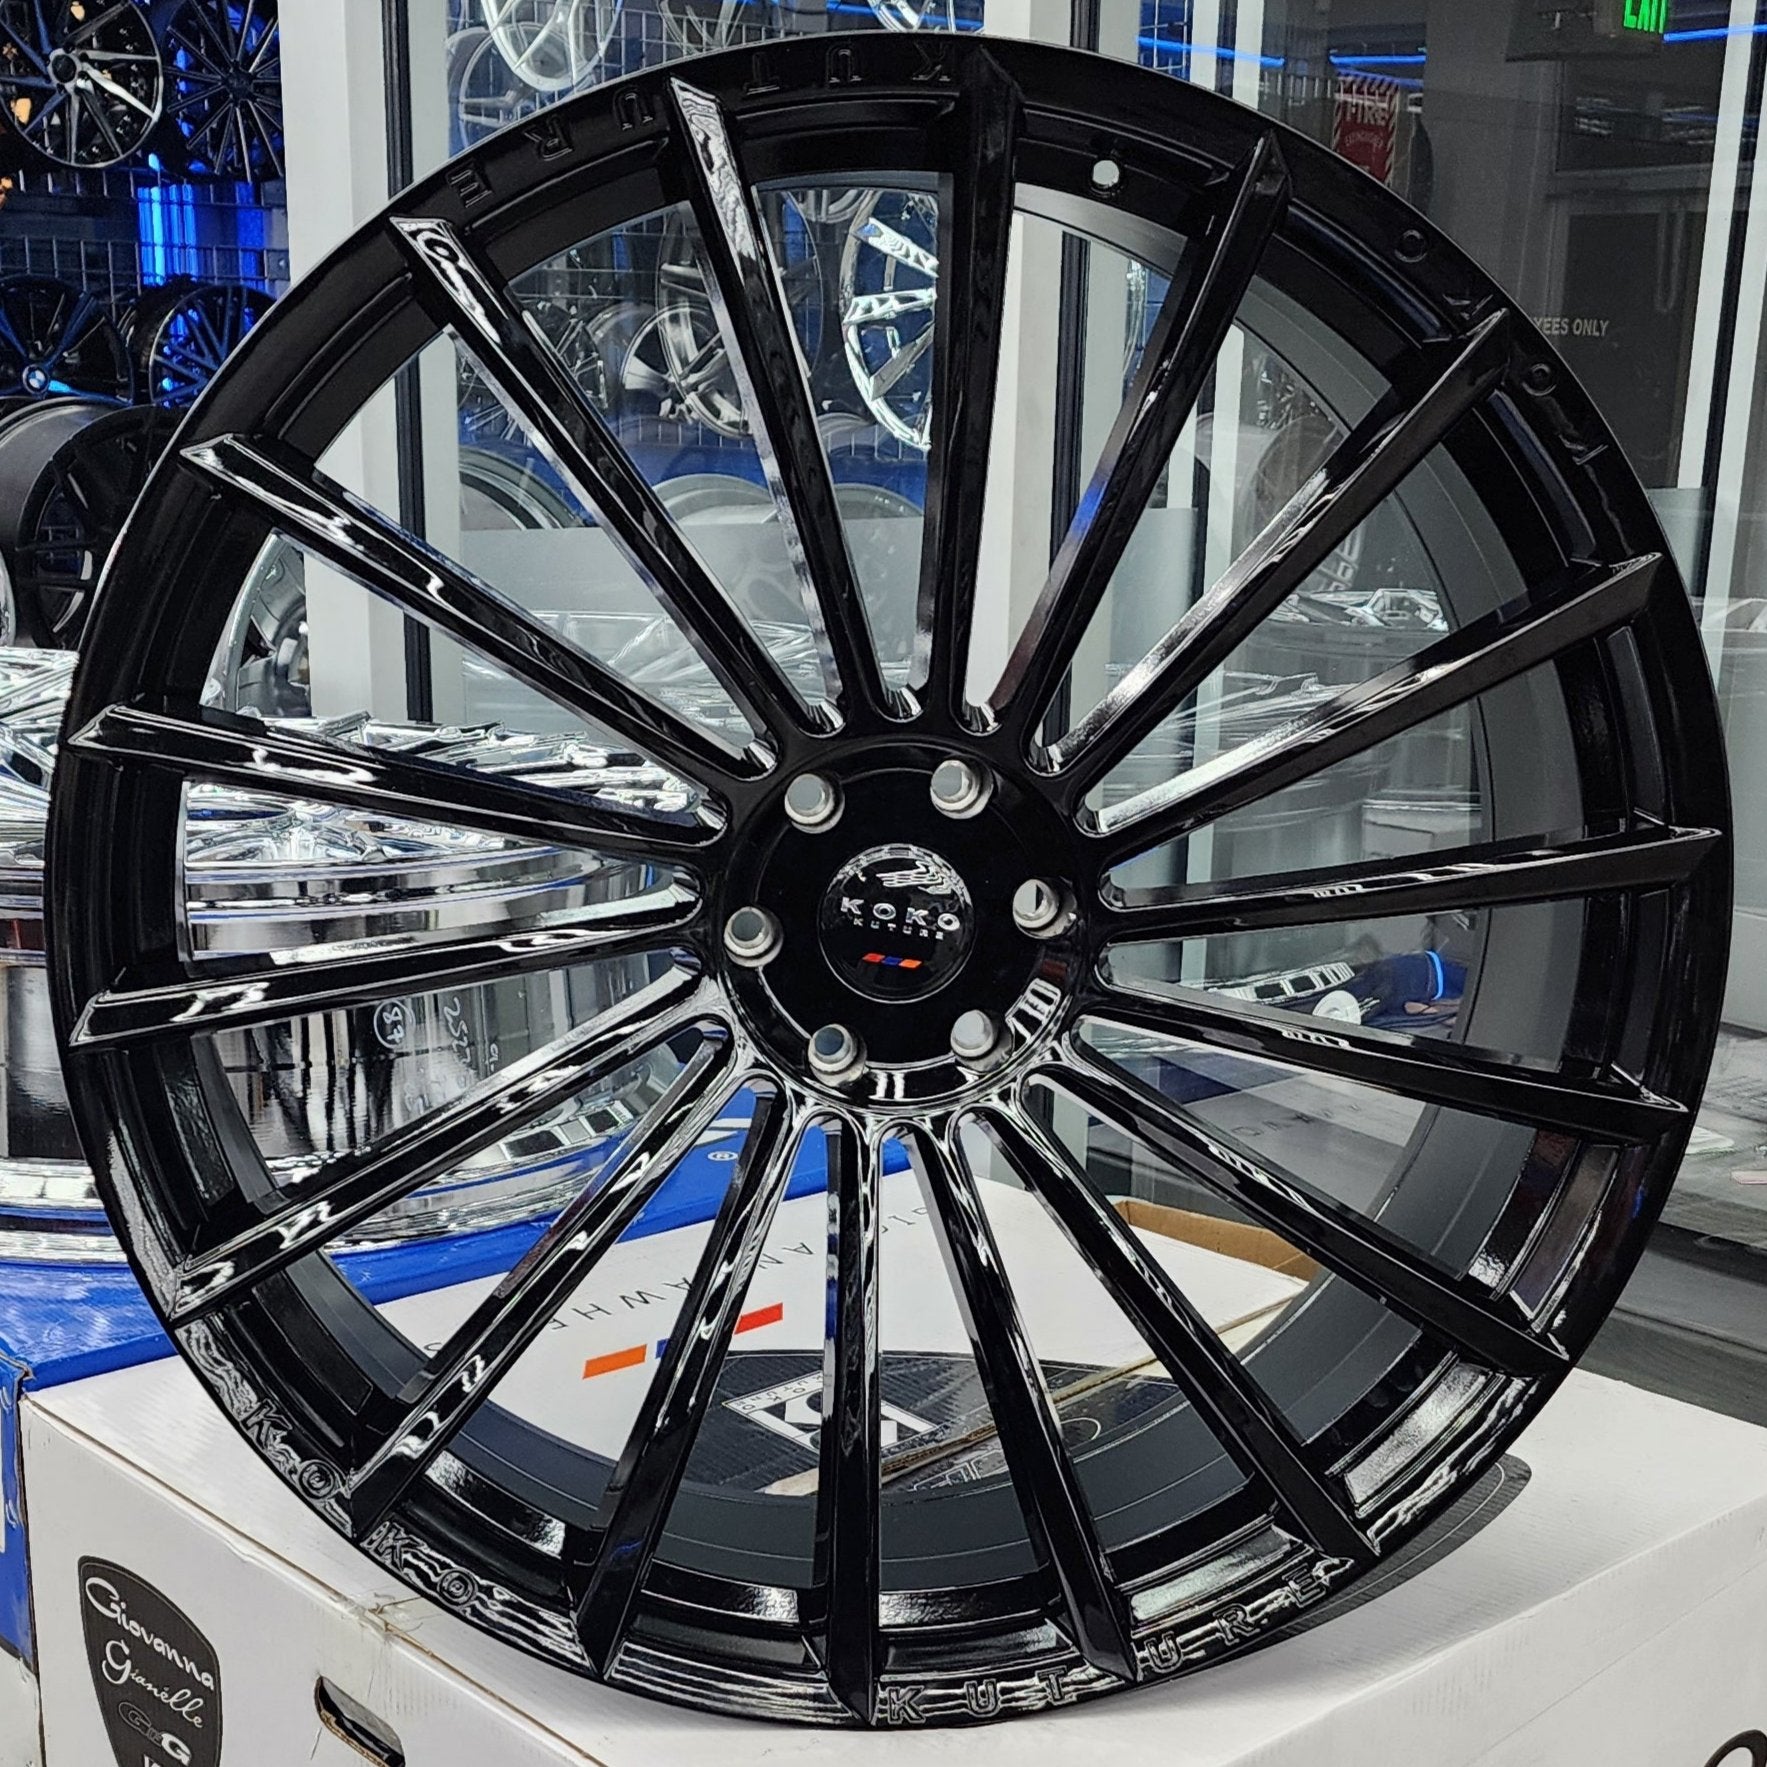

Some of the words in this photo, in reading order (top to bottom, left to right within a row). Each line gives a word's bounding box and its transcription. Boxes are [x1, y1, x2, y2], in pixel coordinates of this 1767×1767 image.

[1572, 318, 1609, 337] ONLY
[840, 896, 961, 931] KOKO
[853, 917, 944, 940] KUTURE
[86, 1577, 214, 1690] Giovanna
[887, 1564, 1327, 1724] KUTURE
